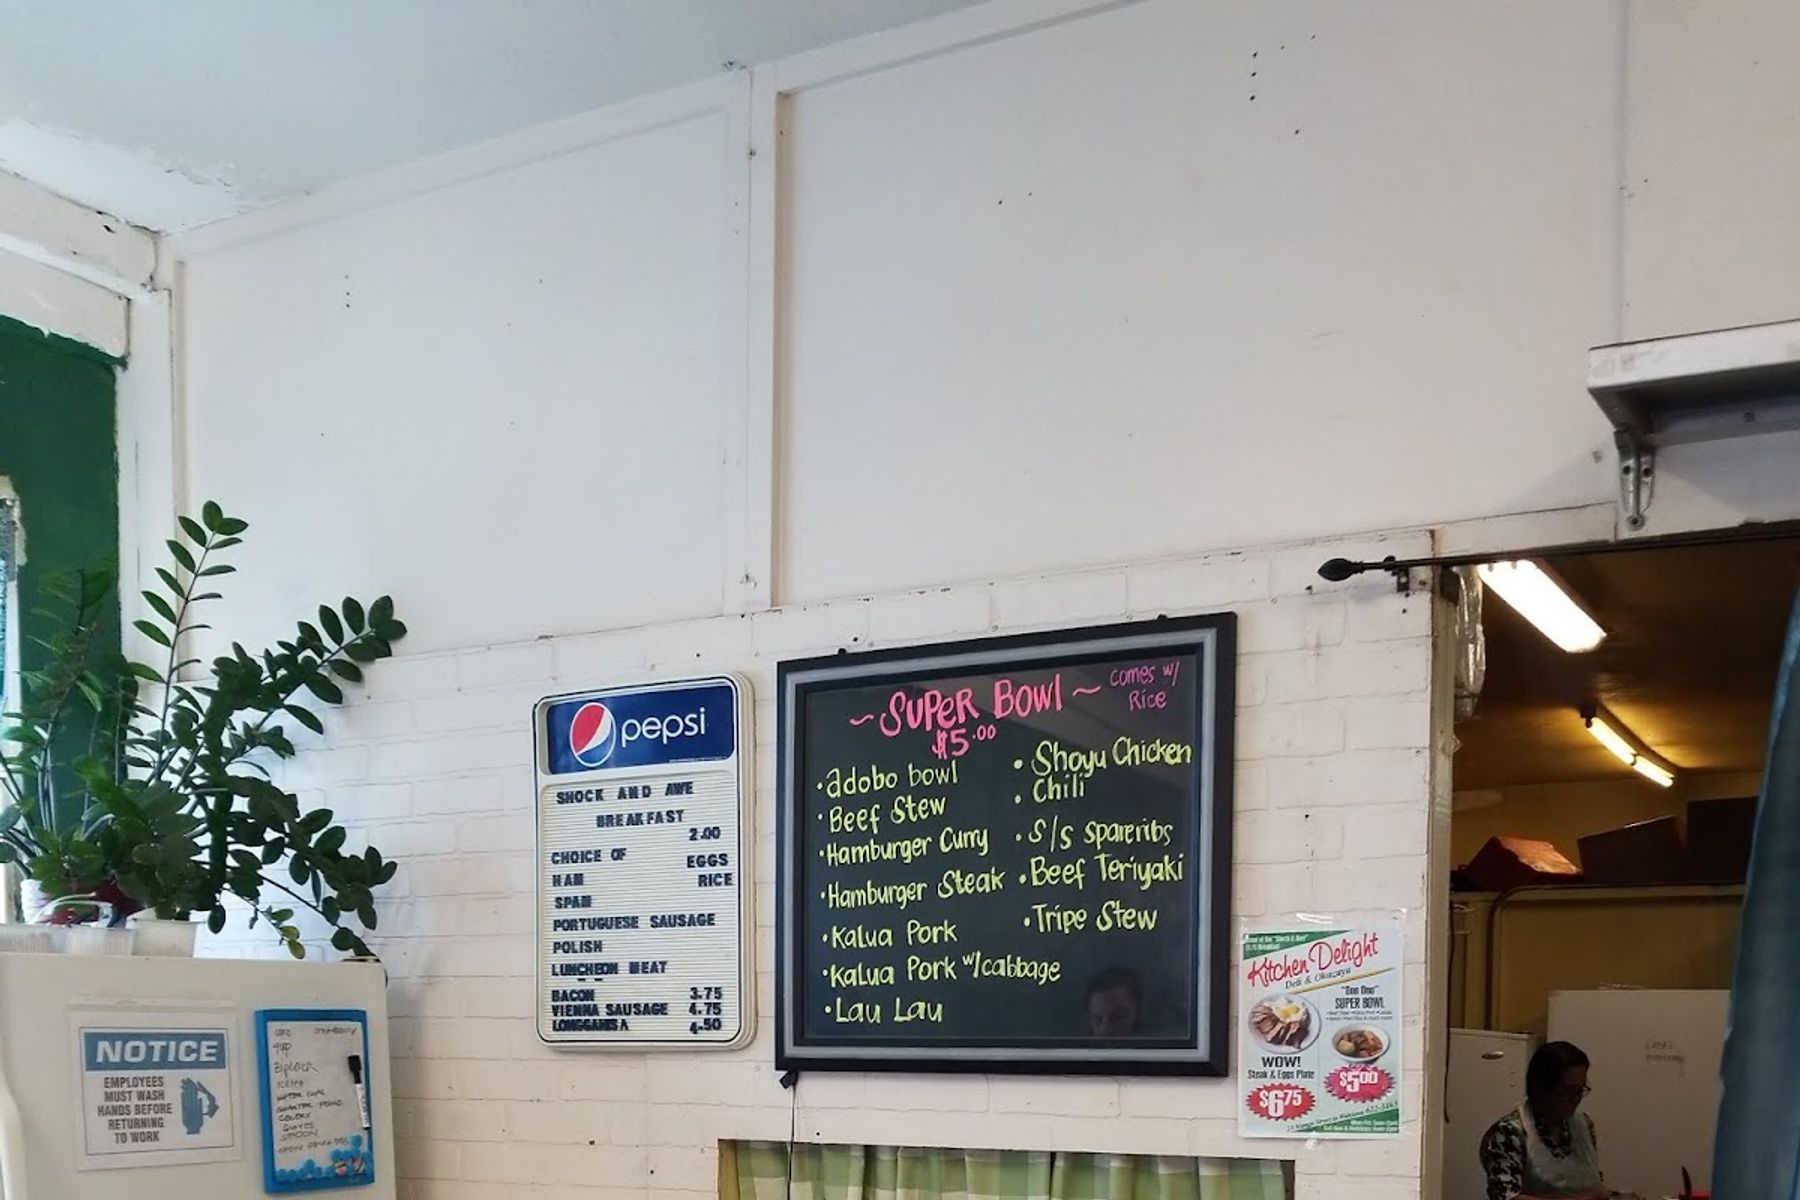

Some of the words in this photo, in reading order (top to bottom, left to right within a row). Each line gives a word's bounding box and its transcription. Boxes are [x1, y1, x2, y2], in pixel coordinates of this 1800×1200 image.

[1129, 690, 1167, 712] Rice
[621, 707, 706, 747] pepsi
[1031, 740, 1107, 779] Shoyu
[1111, 736, 1192, 766] Chicken
[908, 759, 958, 787] bowl
[556, 789, 603, 804] SHOCK
[617, 785, 652, 800] AND
[665, 781, 694, 796] AWE
[1032, 774, 1085, 803] Chili
[596, 809, 685, 828] BREAKFAST
[829, 804, 880, 834] Beef
[890, 794, 946, 824] Stew
[689, 827, 721, 841] 2.00
[826, 837, 933, 867] Hamburger
[939, 826, 989, 857] Curry
[551, 850, 602, 864] CHOICE
[610, 848, 627, 861] OF
[686, 853, 728, 868] EGGS
[552, 873, 584, 887] HAM
[697, 873, 734, 887] RICE
[1030, 855, 1086, 890] Beef
[1094, 853, 1184, 890] Teriyaki
[828, 880, 928, 910] Hamburger
[937, 866, 1006, 899] Steak
[554, 895, 592, 909] SPAM
[553, 916, 639, 931] PORTUGUESE
[650, 913, 716, 928] SAUSAGE
[1032, 903, 1088, 934] Tripe
[1096, 900, 1158, 931] Stew
[907, 919, 958, 945] Pork
[553, 940, 603, 954] POLISH
[907, 955, 957, 981] Pork
[1247, 954, 1309, 987] Kitchen
[1308, 932, 1379, 970] Delight
[551, 962, 619, 976] LUNCHEON
[629, 961, 668, 974] MEAT
[551, 989, 595, 1002] BACON
[690, 987, 722, 1000] 3.75
[1335, 998, 1360, 1009] SUPER
[1362, 997, 1385, 1009] BOWL
[551, 1003, 600, 1017] VIENNA
[605, 1003, 668, 1016] SAUSAGE
[689, 1002, 722, 1016] 4.75
[835, 996, 881, 1024] Lau
[893, 996, 943, 1023] Lau
[689, 1018, 722, 1034] 4.50
[96, 1040, 218, 1063] NOTICE
[1262, 1056, 1301, 1068] WOW!
[103, 1076, 164, 1089] EMPLOYEES
[104, 1090, 132, 1102] MUST
[136, 1090, 165, 1101] WASH
[97, 1104, 131, 1117] HANDS
[134, 1103, 172, 1115] BEFORE
[108, 1117, 164, 1130] RETURNING
[114, 1132, 127, 1144] TO
[130, 1131, 160, 1143] WORK
